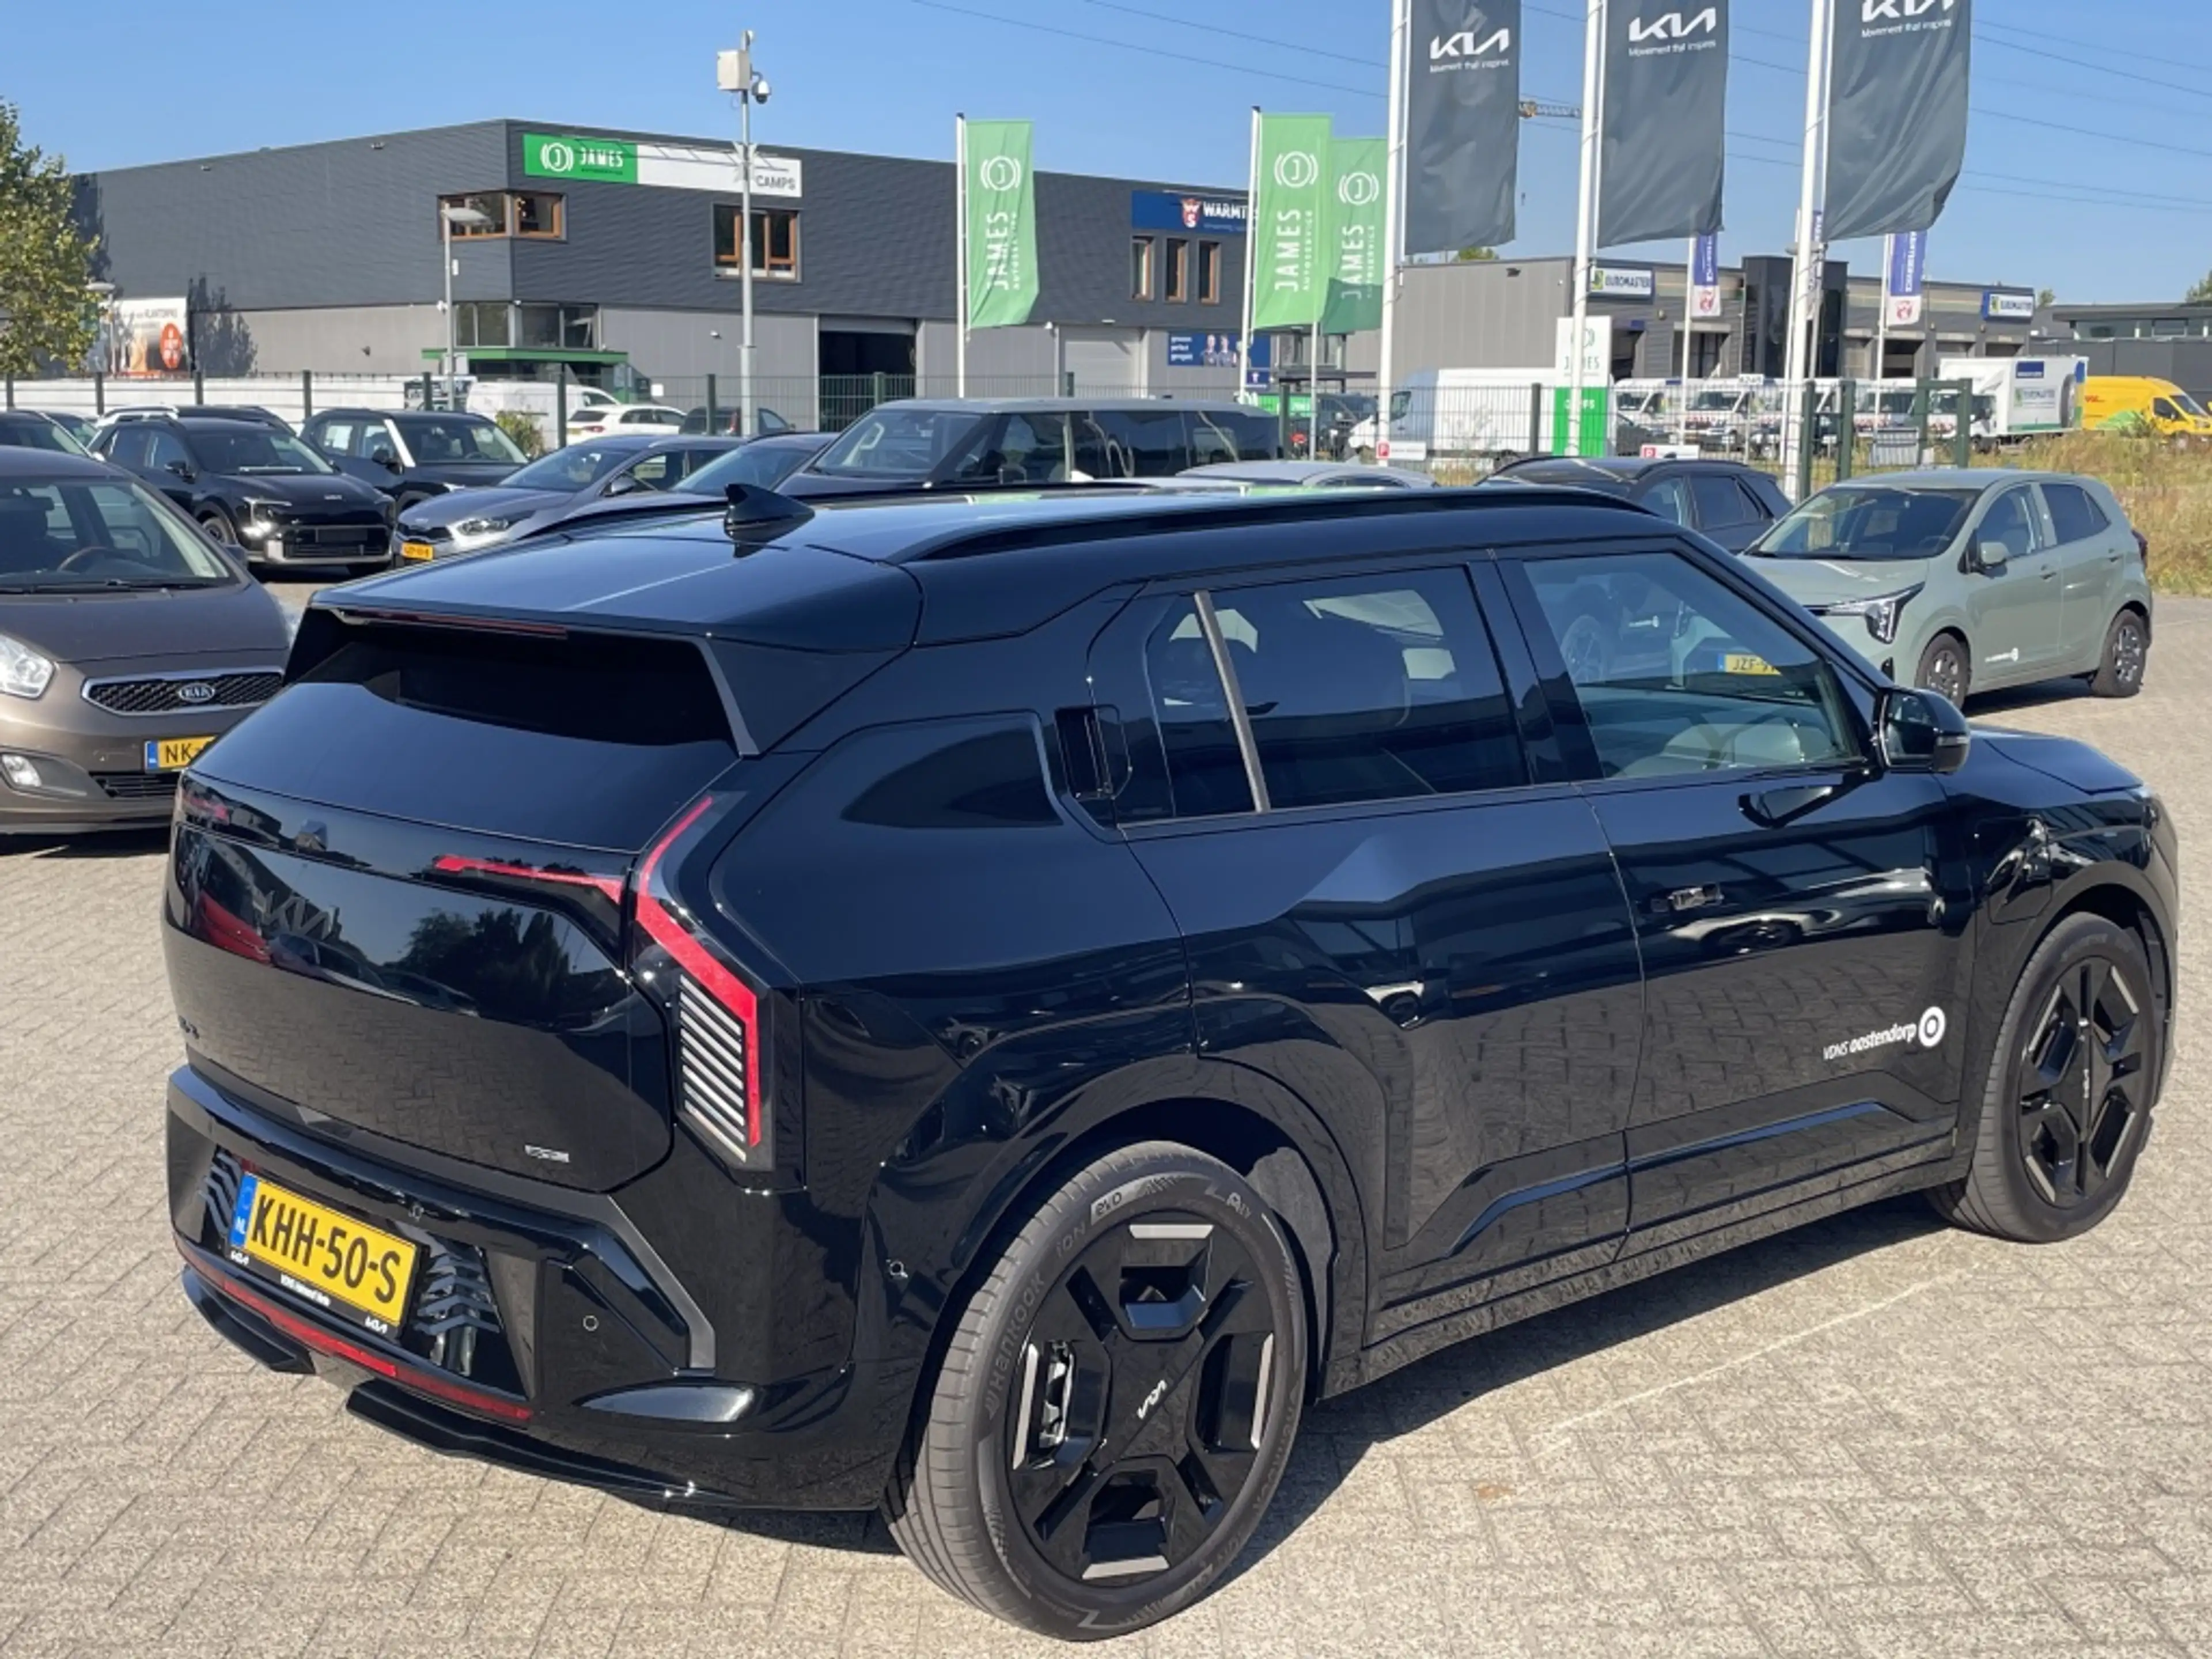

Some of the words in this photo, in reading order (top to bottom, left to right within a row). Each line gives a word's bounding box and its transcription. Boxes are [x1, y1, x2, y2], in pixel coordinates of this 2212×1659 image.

[1629, 7, 1715, 41] KIA
[1430, 28, 1509, 59] KIA
[579, 147, 623, 168] JAMES
[756, 175, 796, 191] CAMPS
[1203, 202, 1259, 219] WARMT
[986, 212, 1009, 290] JAMES
[1274, 209, 1301, 291] JAMES
[1303, 210, 1313, 291] AUTOSERVICE
[1341, 225, 1364, 300] JAMES
[1564, 356, 1599, 370] JES
[251, 1194, 400, 1304] KHH-50-S
